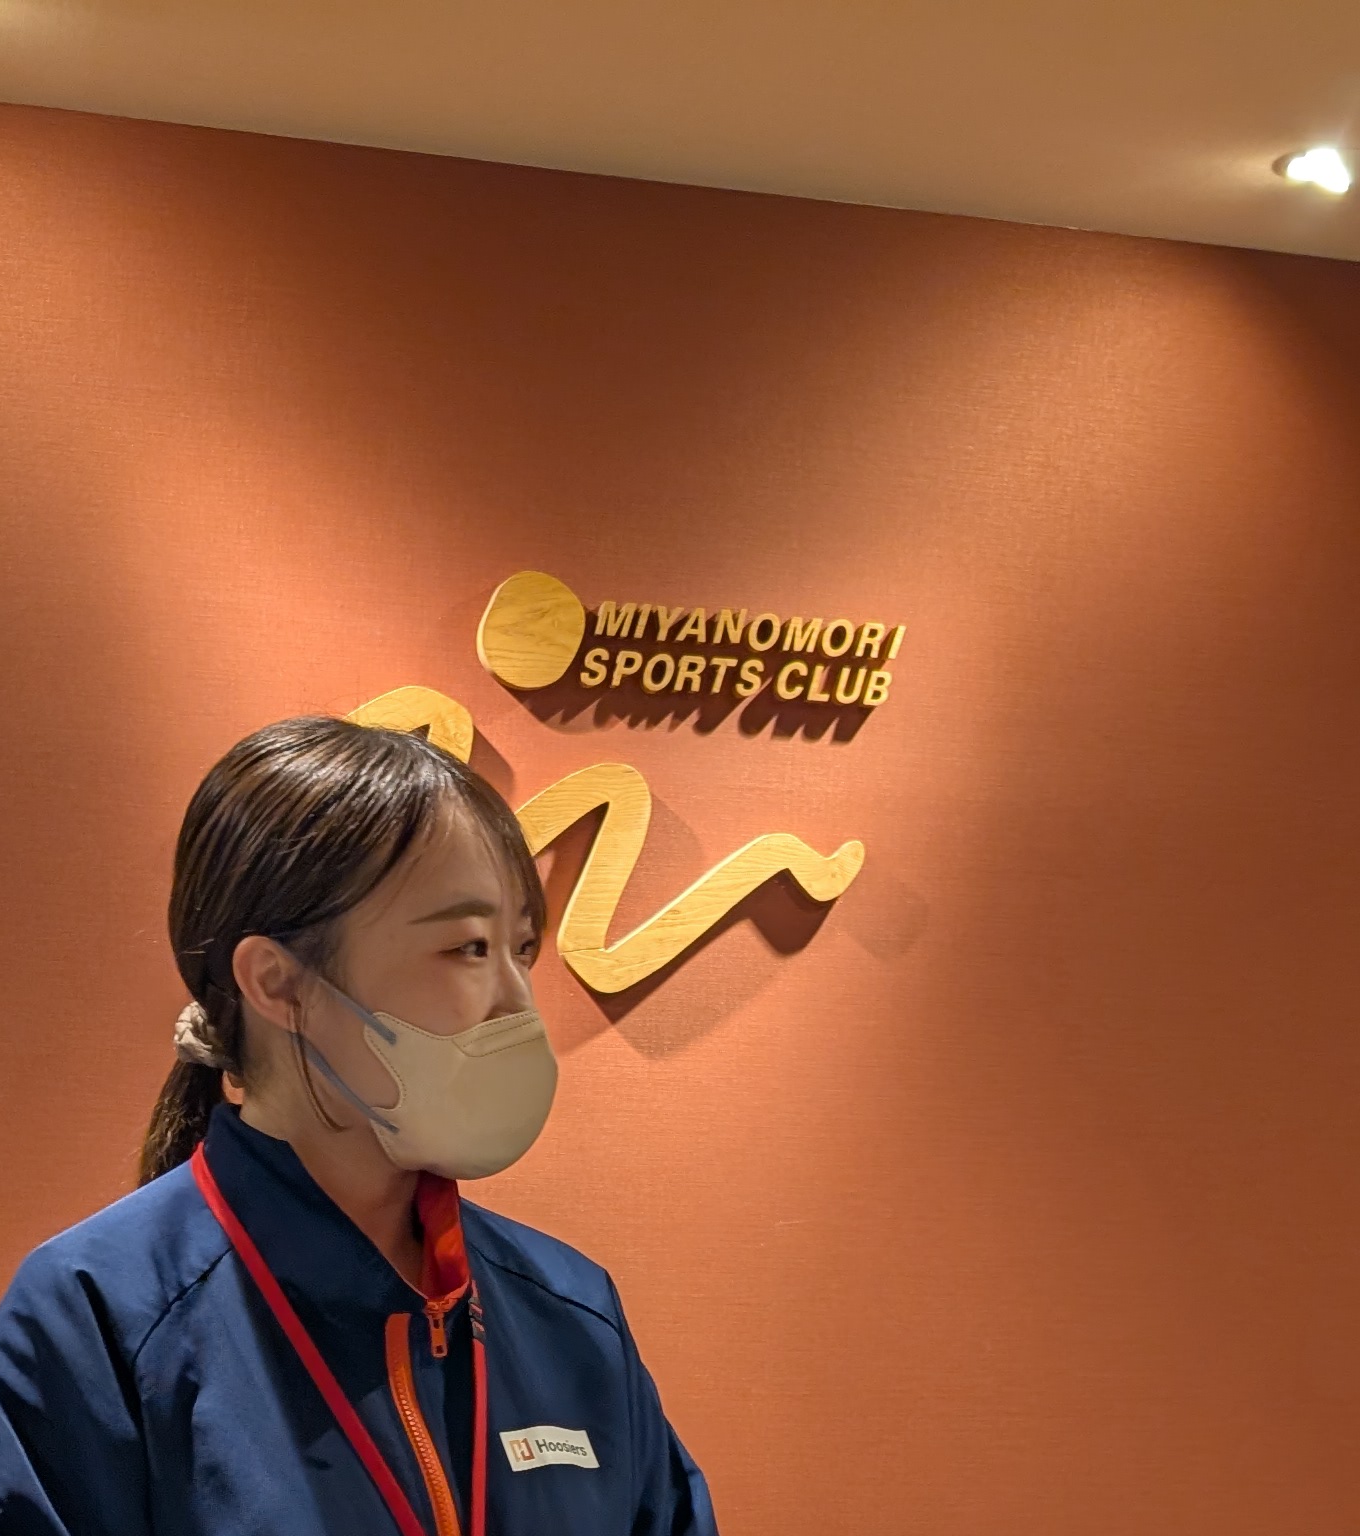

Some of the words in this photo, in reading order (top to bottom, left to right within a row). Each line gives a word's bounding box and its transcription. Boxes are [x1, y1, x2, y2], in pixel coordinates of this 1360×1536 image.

[594, 600, 907, 661] MIYANOMORI
[580, 647, 765, 698] SPORTS
[776, 661, 893, 707] CLUB
[535, 1439, 588, 1457] Hoosiers
